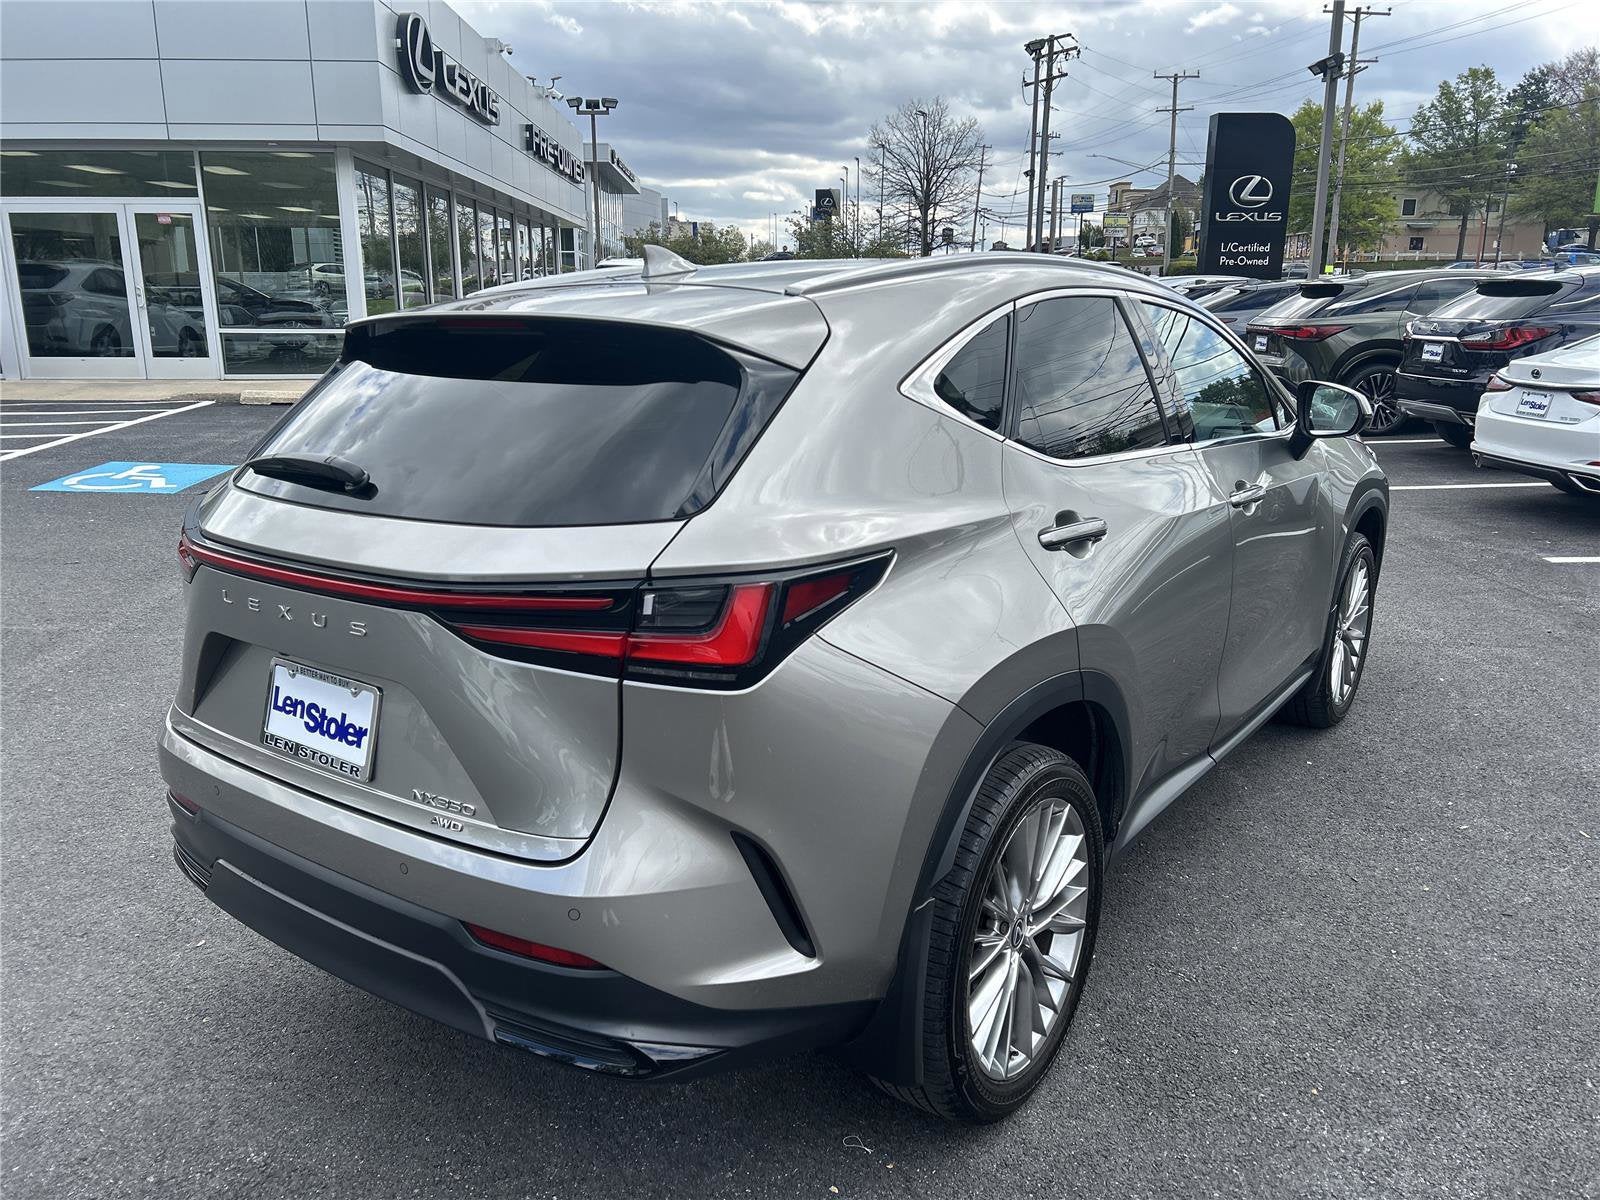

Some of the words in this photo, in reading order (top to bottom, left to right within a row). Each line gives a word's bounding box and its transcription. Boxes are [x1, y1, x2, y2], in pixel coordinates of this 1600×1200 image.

[434, 50, 500, 126] LEXUS
[526, 124, 586, 184] PRE-OWNED
[1215, 212, 1282, 222] LEXUS
[1221, 242, 1270, 252] L/Certified
[1219, 255, 1269, 266] Pre-Owned
[221, 589, 368, 637] LEXUS
[300, 666, 319, 678] BETTER
[320, 672, 330, 682] WAY
[338, 677, 350, 688] BUY
[264, 734, 295, 754] LEN
[298, 745, 361, 778] STOLER
[411, 788, 476, 816] NX350
[430, 815, 464, 832] AWD
